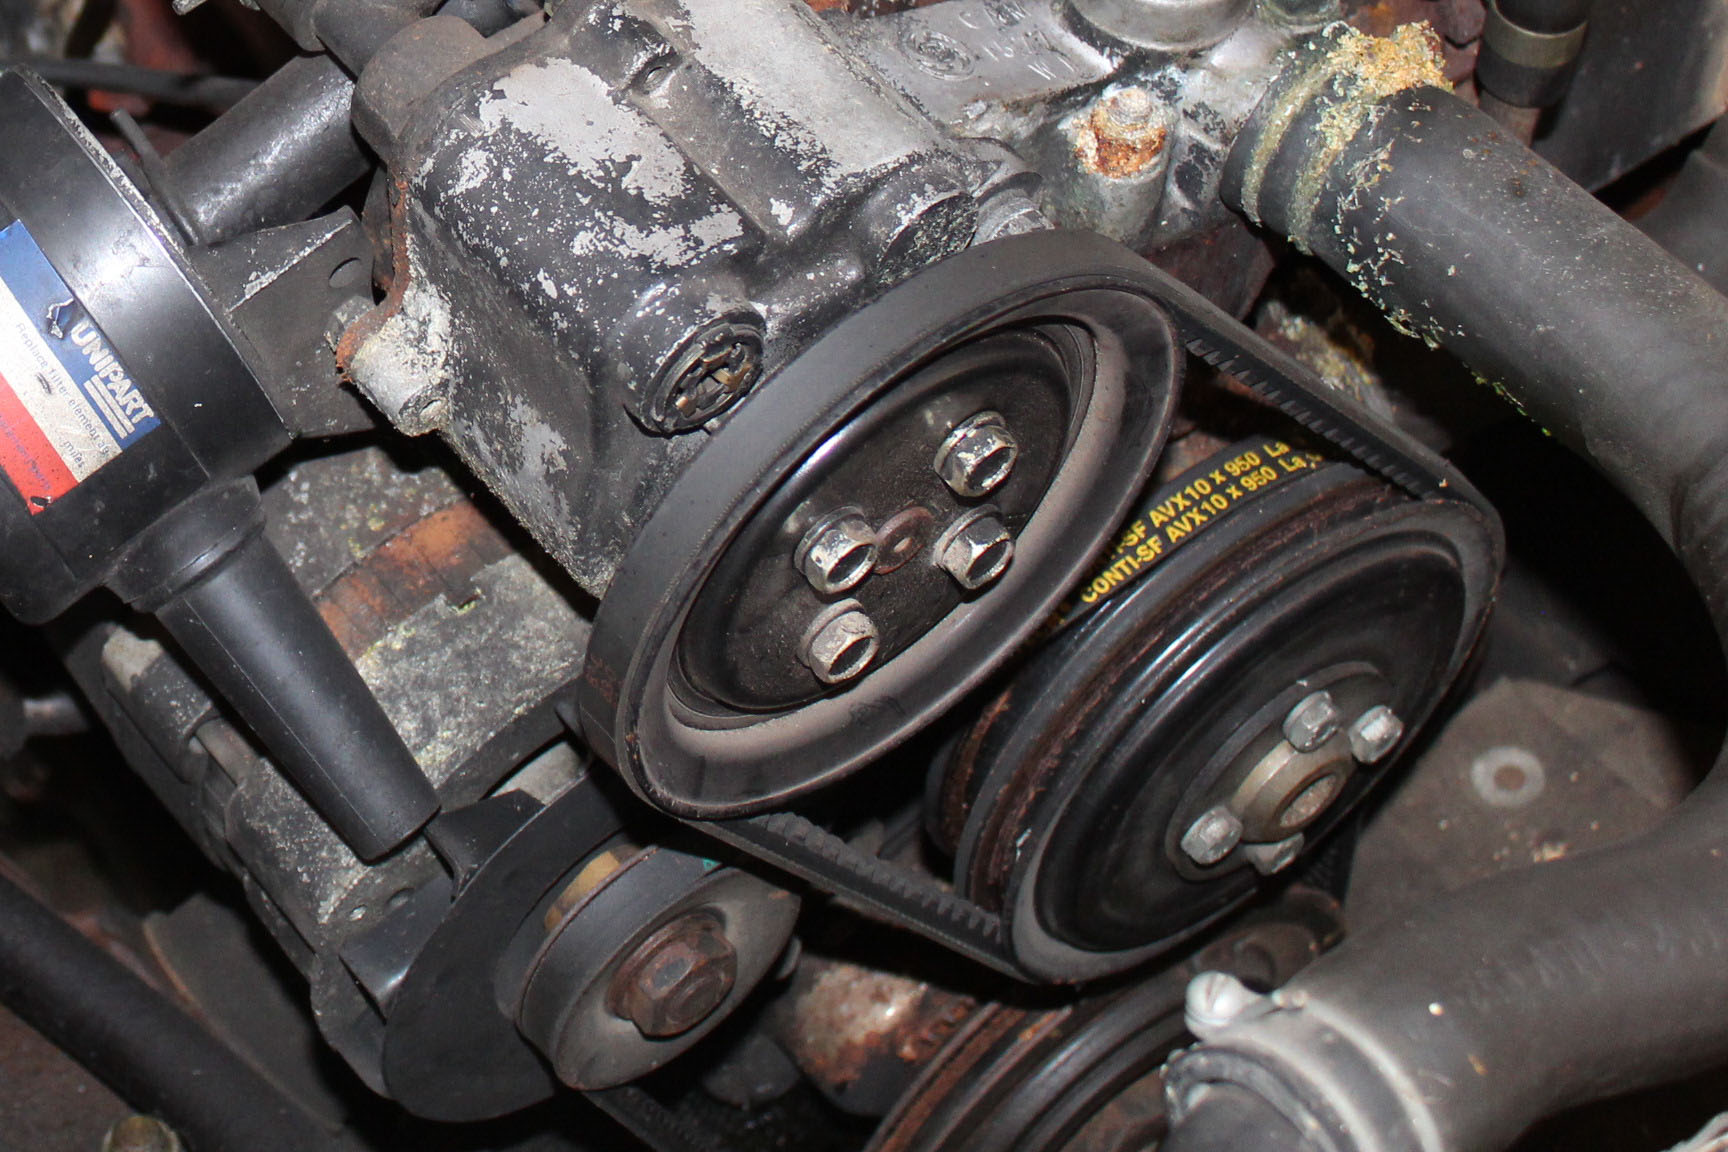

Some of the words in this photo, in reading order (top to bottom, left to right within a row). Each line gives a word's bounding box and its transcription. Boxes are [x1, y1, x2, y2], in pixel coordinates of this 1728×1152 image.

[16, 323, 49, 368] Replace
[47, 367, 70, 398] filter
[67, 398, 101, 440] element
[70, 321, 154, 424] UNIPART
[1082, 536, 1163, 603] CONTI-SF
[1166, 493, 1229, 544] AVX10
[1240, 463, 1279, 492] 950
[1150, 478, 1213, 528] AVX10
[1224, 451, 1263, 477] 950
